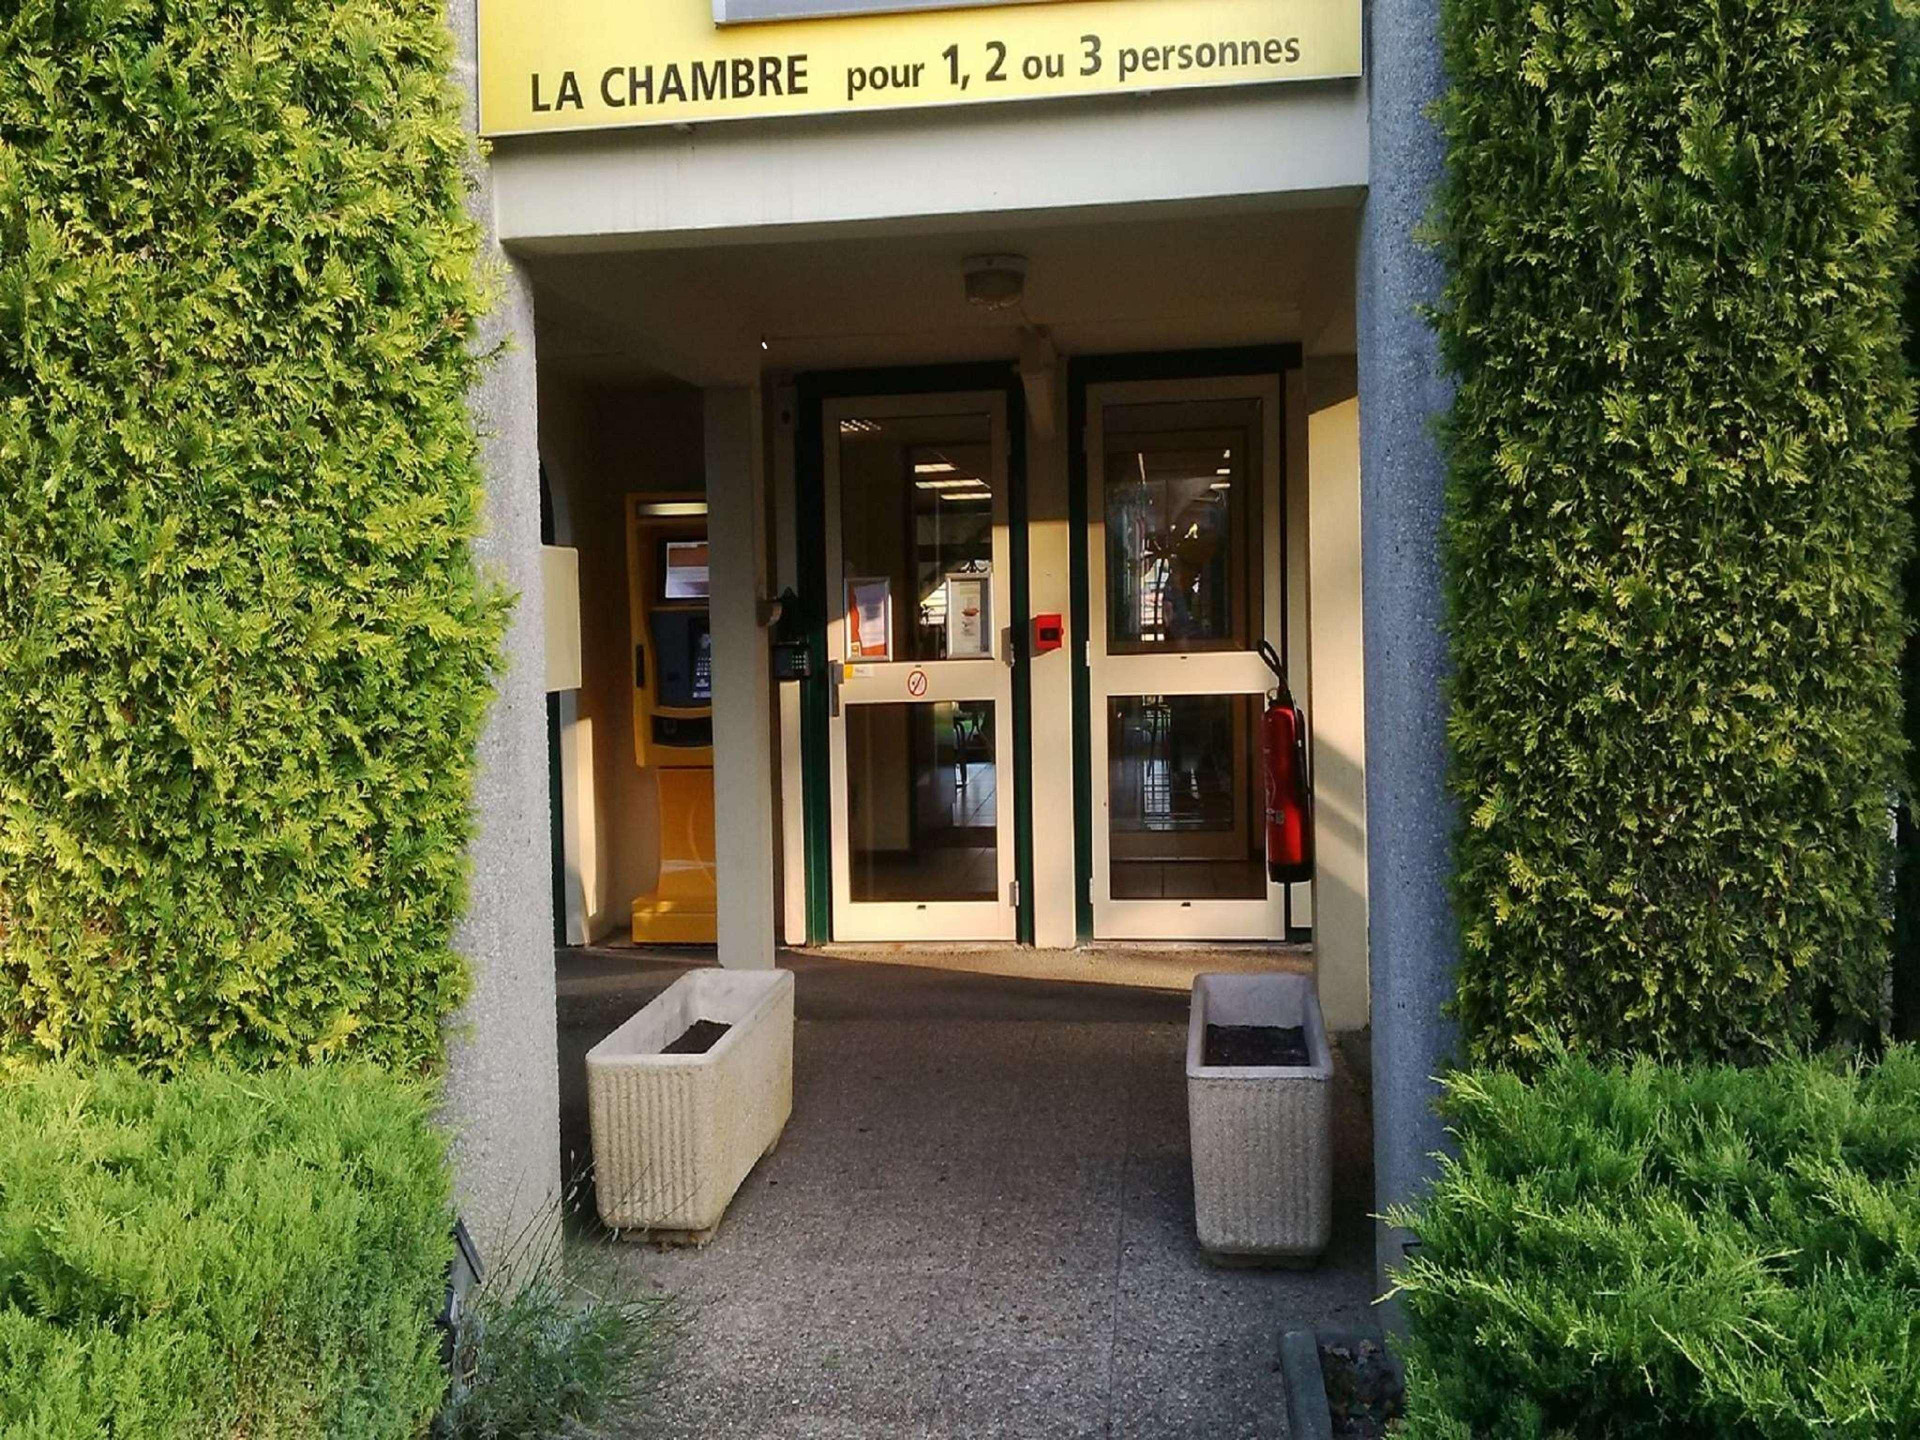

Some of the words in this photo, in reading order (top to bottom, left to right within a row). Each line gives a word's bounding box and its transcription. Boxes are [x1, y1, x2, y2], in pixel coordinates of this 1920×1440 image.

[531, 72, 584, 112] LA
[601, 55, 808, 108] CHAMBRE
[847, 63, 925, 101] pour
[942, 44, 970, 90] 1,
[986, 41, 1007, 82] 2
[1022, 54, 1064, 80] ou
[1080, 35, 1102, 76] 3
[1119, 37, 1300, 82] personnes
